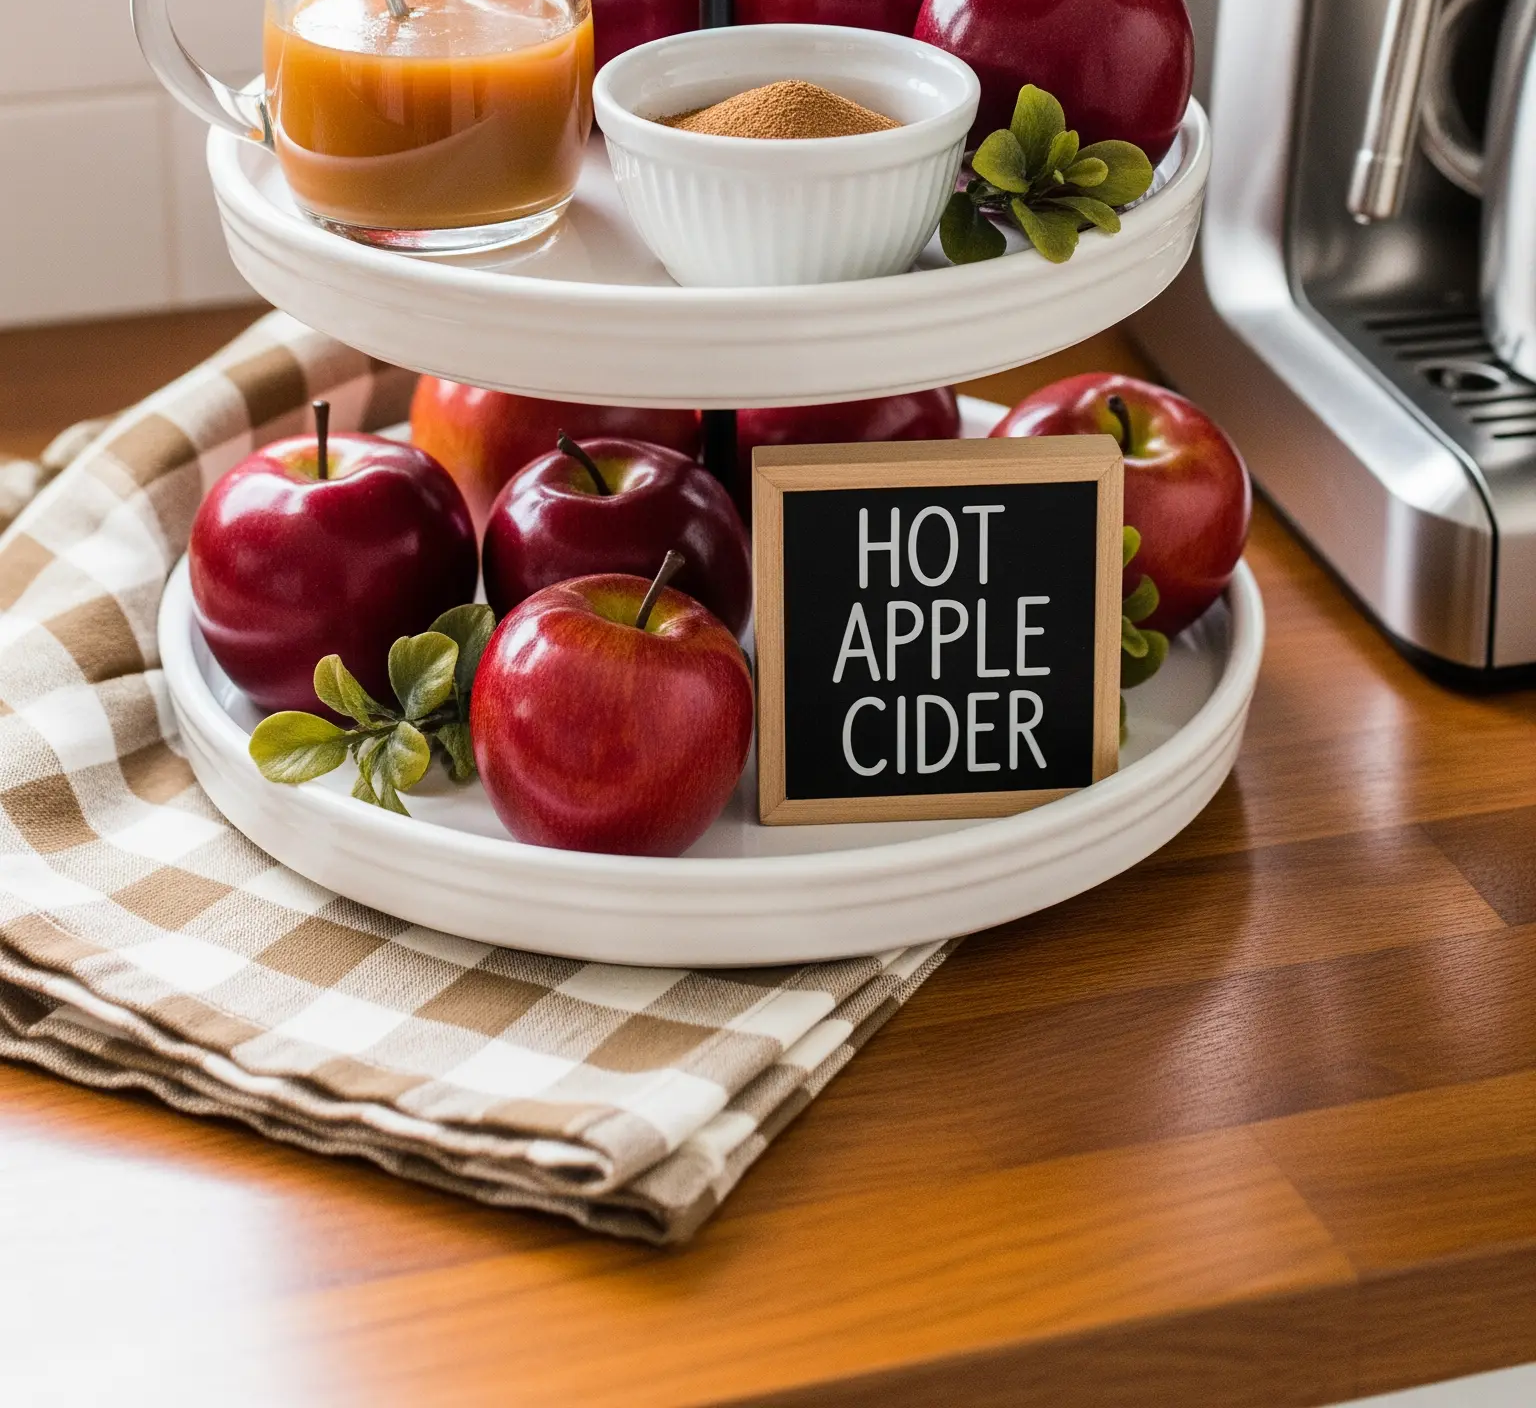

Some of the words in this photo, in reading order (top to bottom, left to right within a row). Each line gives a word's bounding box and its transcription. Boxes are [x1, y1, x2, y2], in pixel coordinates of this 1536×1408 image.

[858, 504, 1006, 589] HOT
[832, 595, 1051, 684] APPLE
[842, 689, 1047, 777] CIDER
